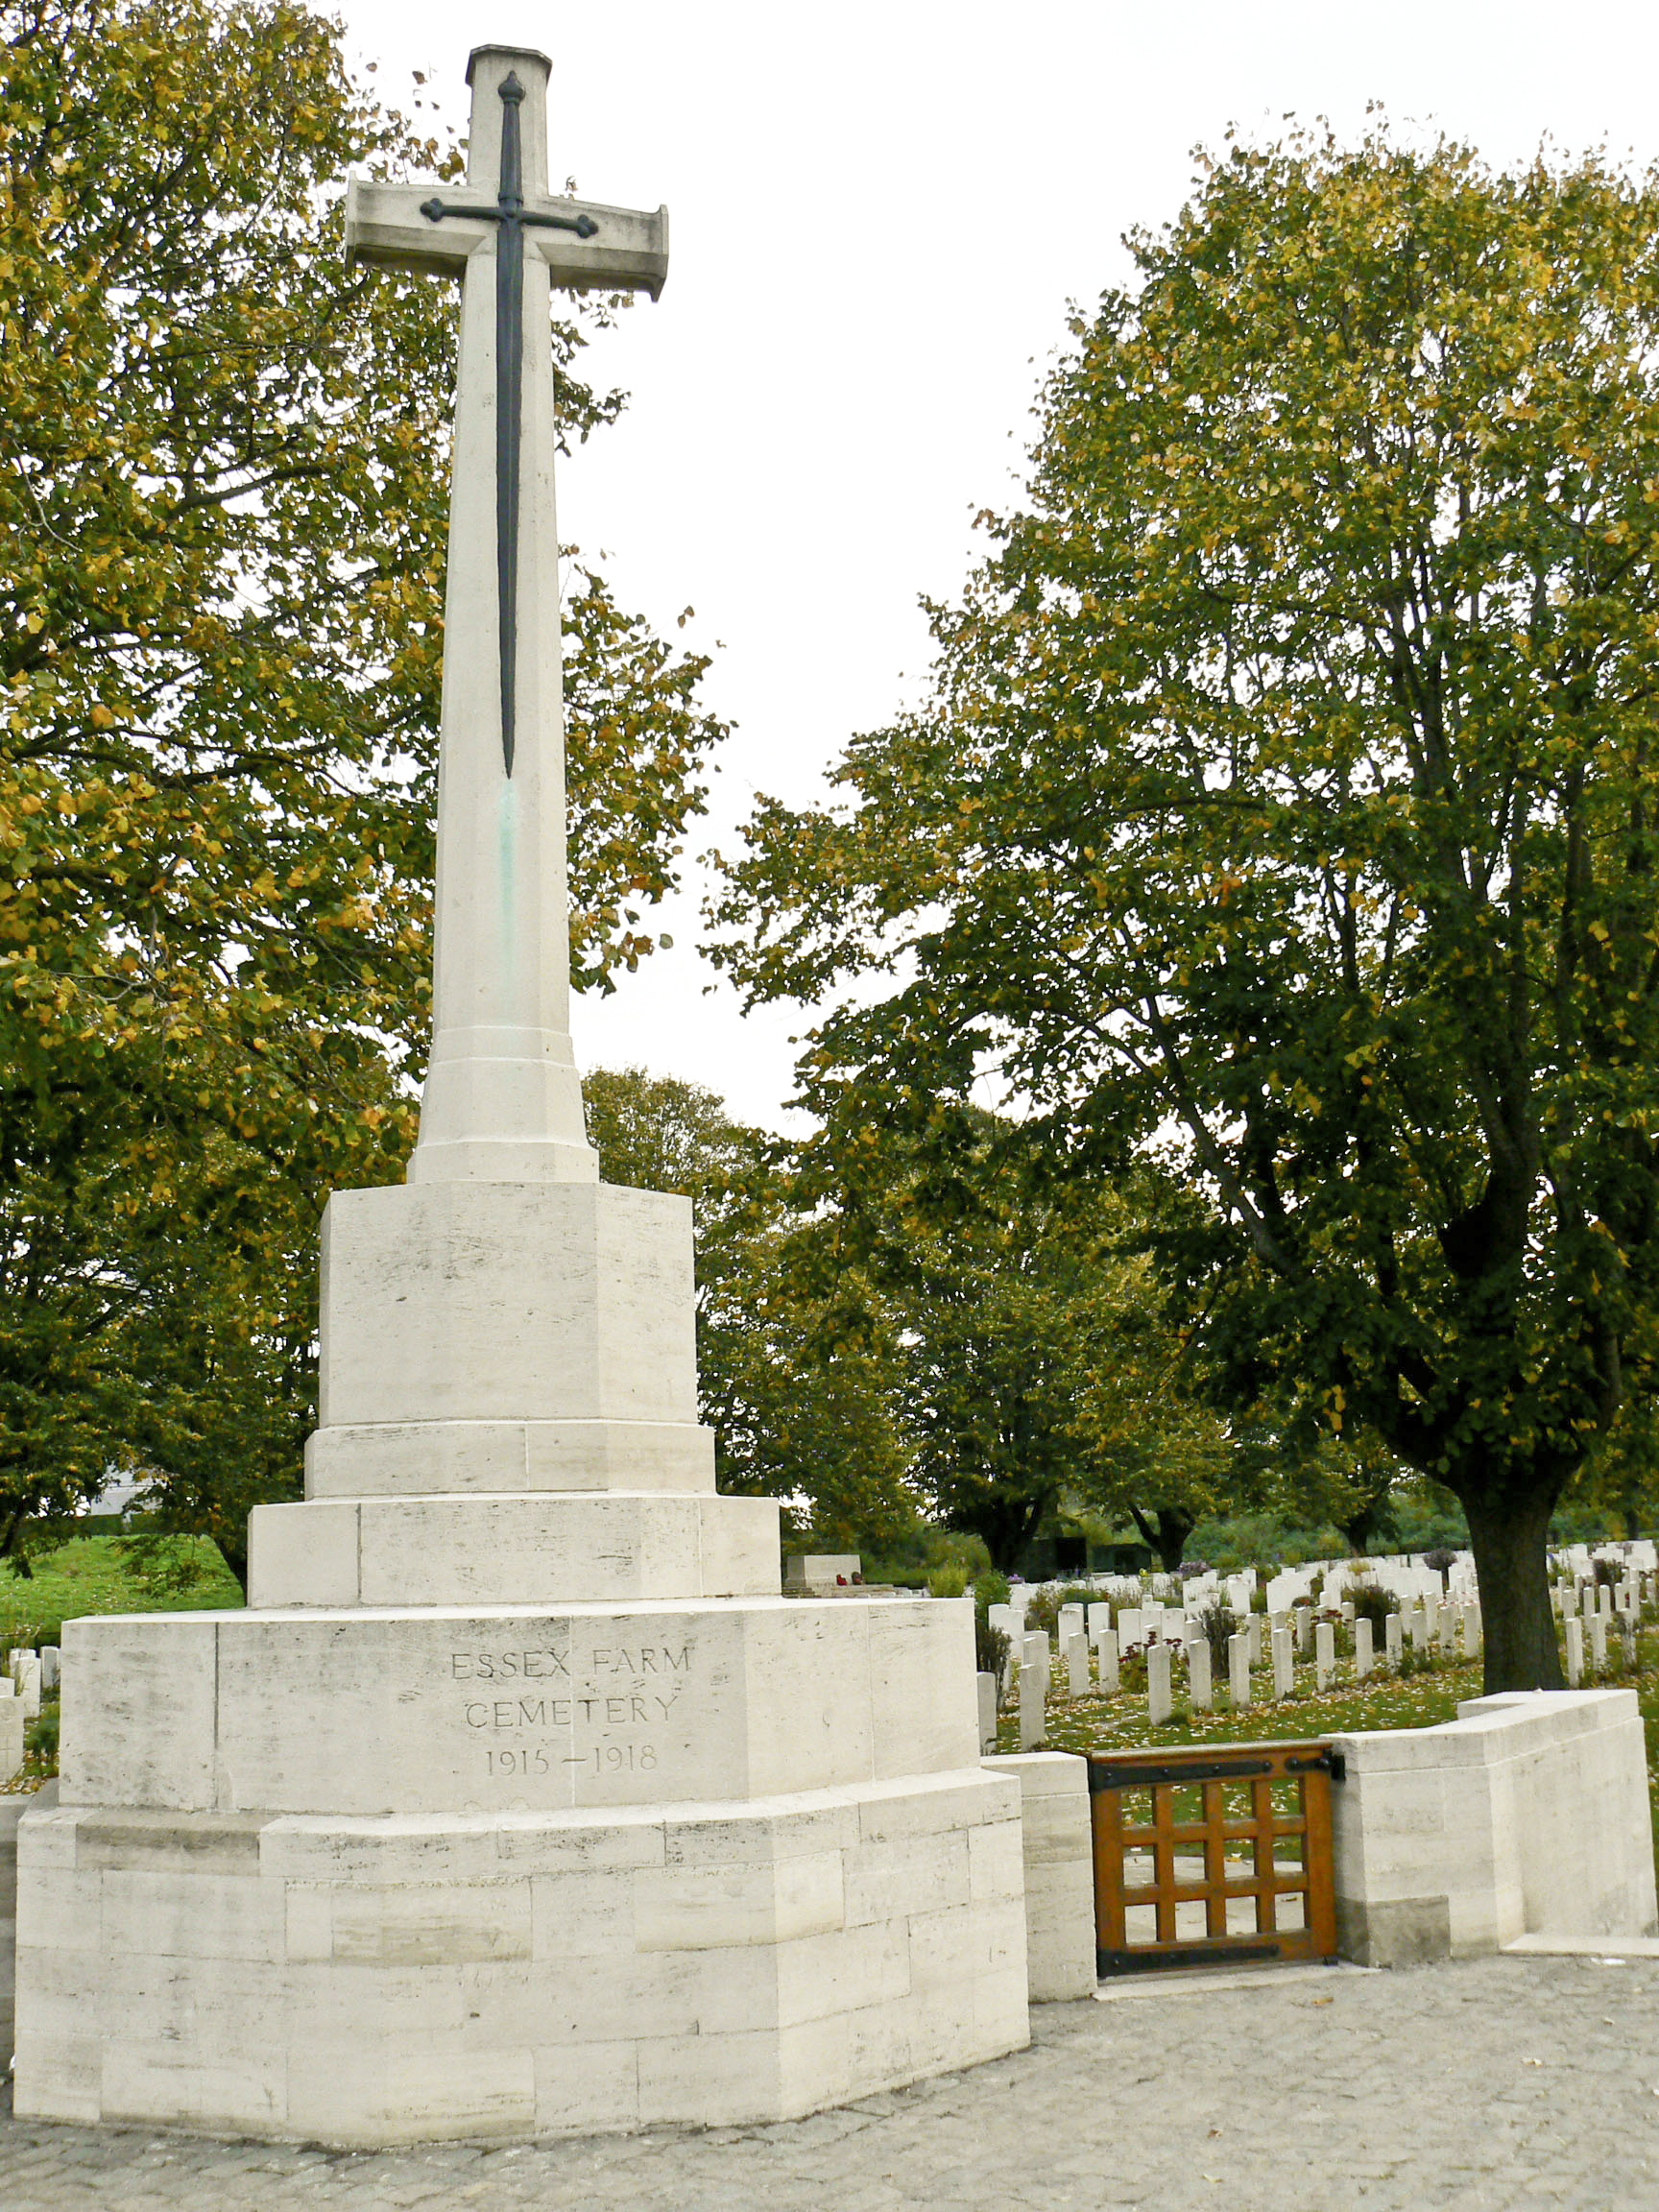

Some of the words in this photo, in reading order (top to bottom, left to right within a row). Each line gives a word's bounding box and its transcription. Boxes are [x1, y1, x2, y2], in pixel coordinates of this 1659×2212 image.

[451, 1650, 571, 1679] ESSEX
[591, 1647, 690, 1674] FARM
[466, 1695, 678, 1728] CEMETERY
